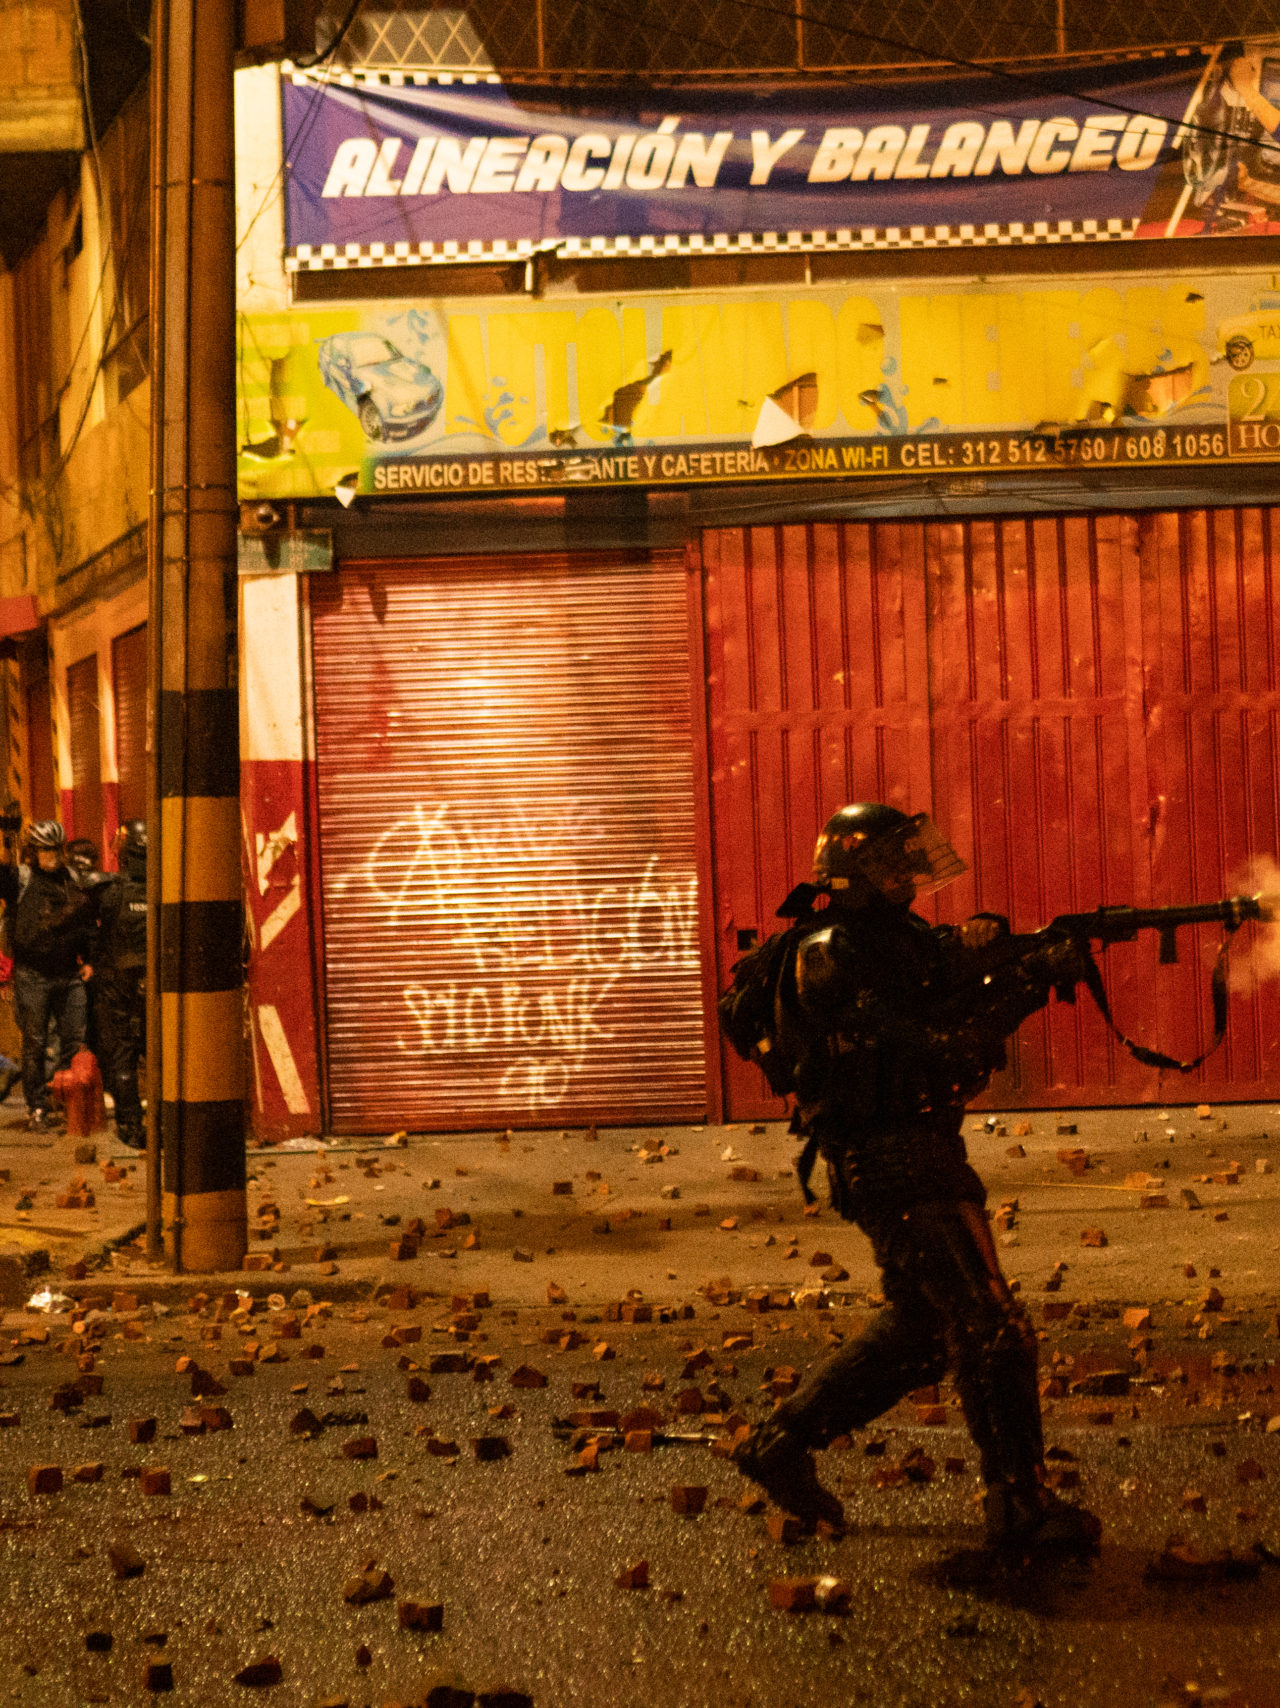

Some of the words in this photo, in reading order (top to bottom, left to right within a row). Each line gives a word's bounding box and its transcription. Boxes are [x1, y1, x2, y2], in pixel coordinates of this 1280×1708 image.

[321, 116, 734, 198] ALINEACIÓN
[749, 128, 805, 185] Y
[807, 114, 1169, 184] BALANCEO
[374, 462, 463, 489] SERVICIO
[469, 461, 494, 485] DE
[643, 456, 658, 477] Y
[661, 447, 769, 477] CAFETERÍA
[785, 447, 838, 471] ZONA
[842, 446, 889, 469] WI-FI
[901, 443, 954, 467] CEL:
[962, 441, 1001, 465] 312
[1008, 438, 1046, 463] 512
[1054, 437, 1105, 462] 5760
[1125, 434, 1166, 459] 608
[1173, 433, 1224, 457] 1056
